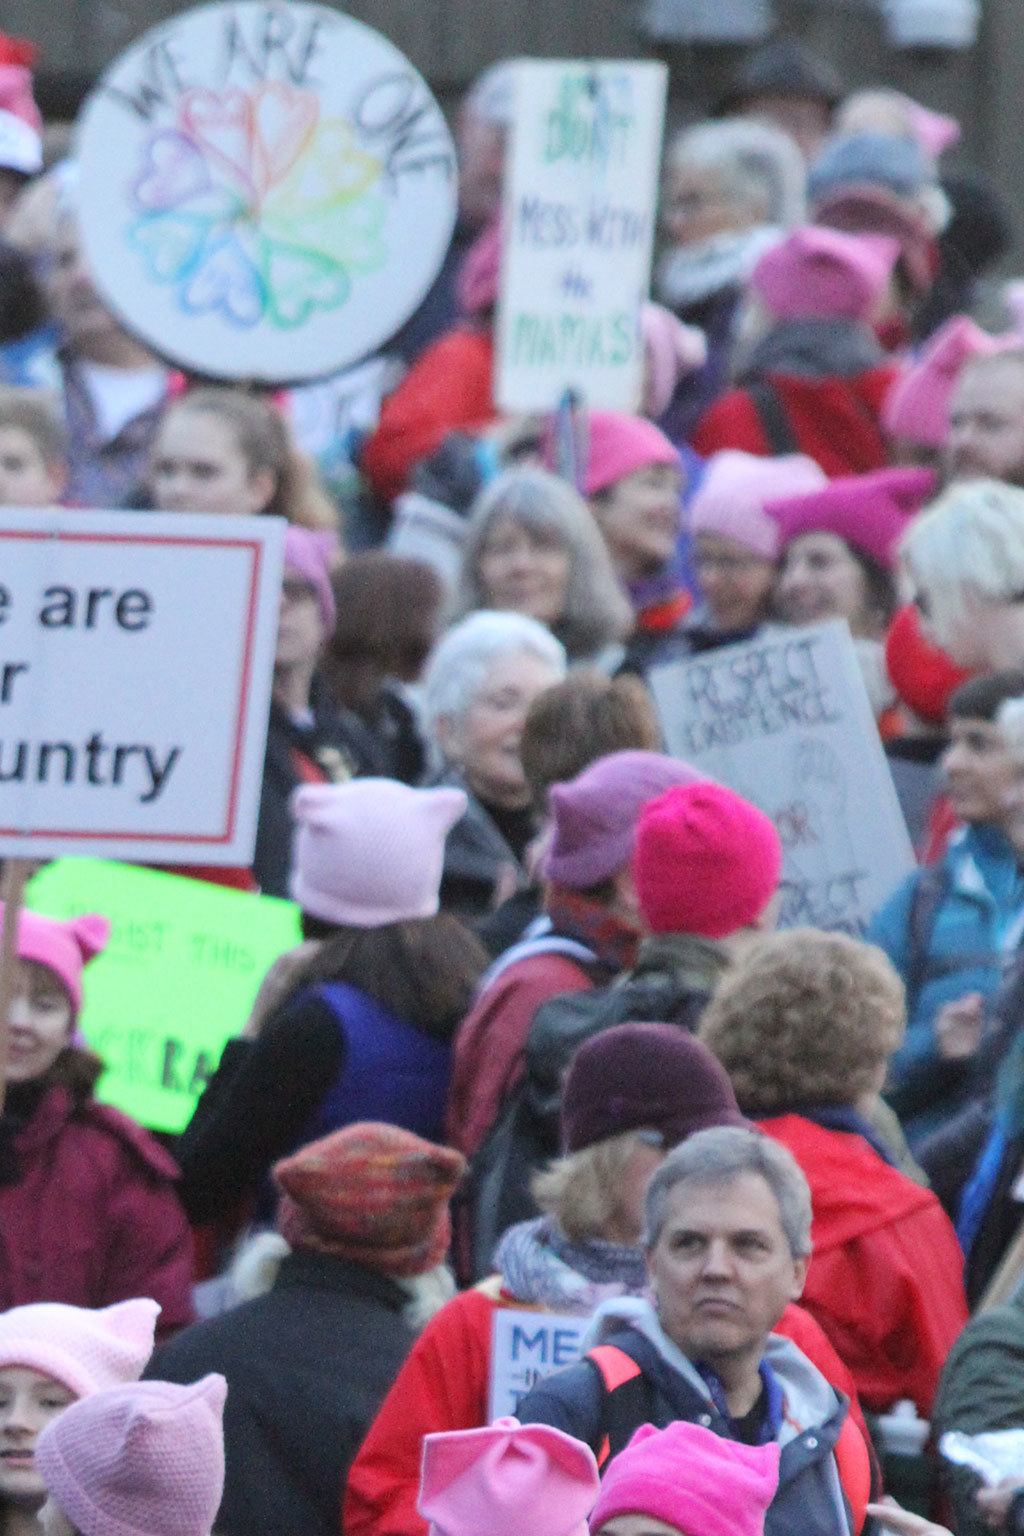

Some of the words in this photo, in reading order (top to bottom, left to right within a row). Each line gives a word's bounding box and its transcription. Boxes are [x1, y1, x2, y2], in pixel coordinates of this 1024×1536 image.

[224, 4, 325, 90] ARE
[357, 72, 454, 197] ONE
[38, 584, 154, 632] are
[511, 1325, 580, 1366] ME
